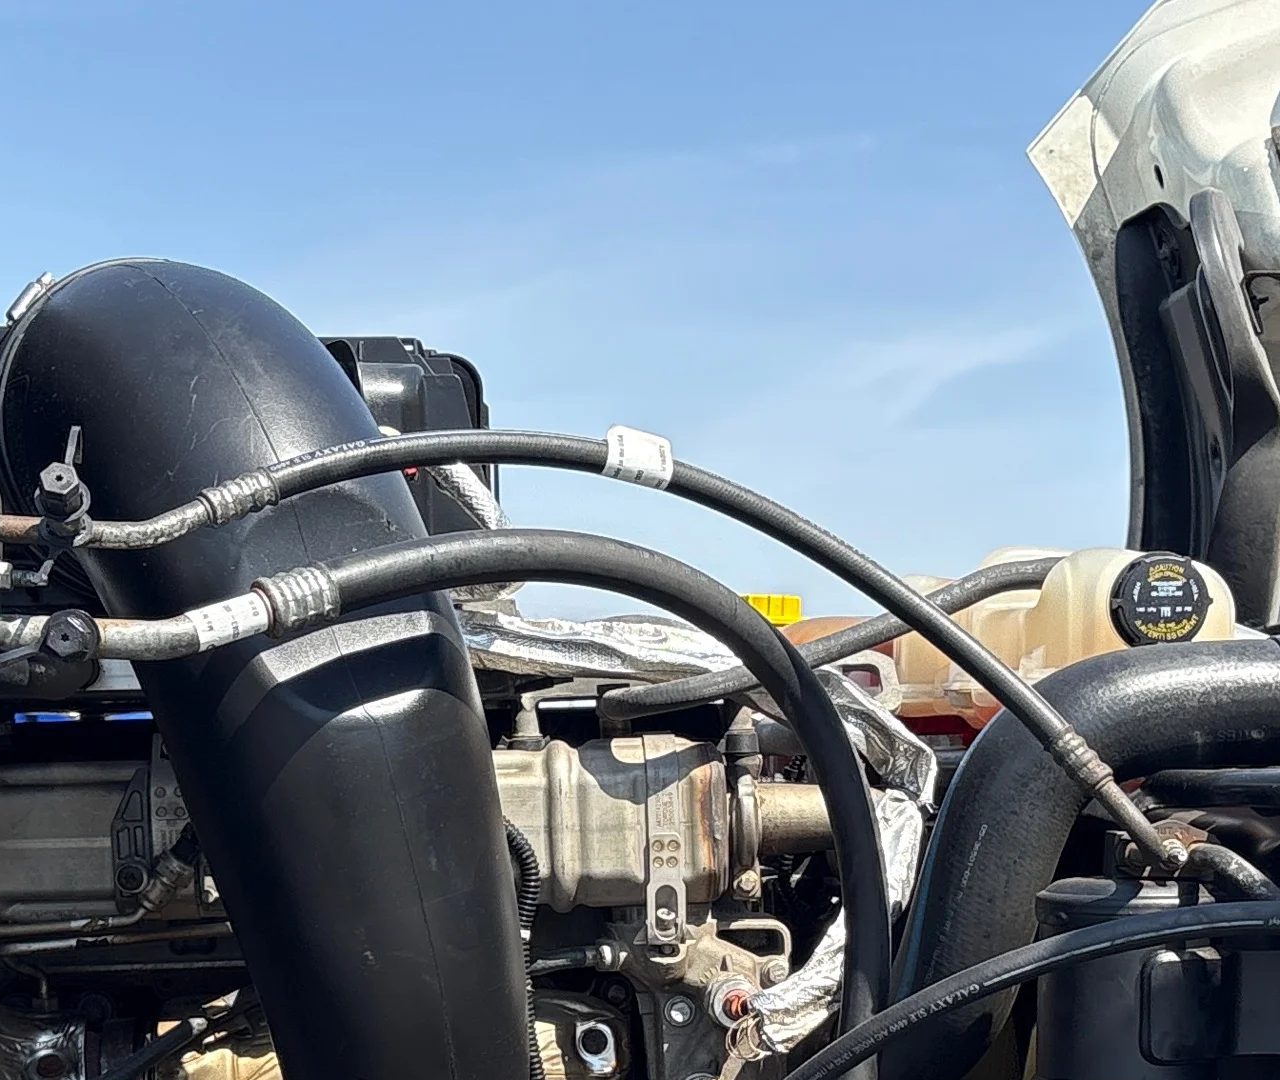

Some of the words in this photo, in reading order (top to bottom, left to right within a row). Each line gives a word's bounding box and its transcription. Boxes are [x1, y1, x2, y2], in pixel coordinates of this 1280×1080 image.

[929, 983, 980, 1014] GALAXY
[910, 1007, 928, 1024] SLE
[854, 1038, 876, 1054] HOSE
